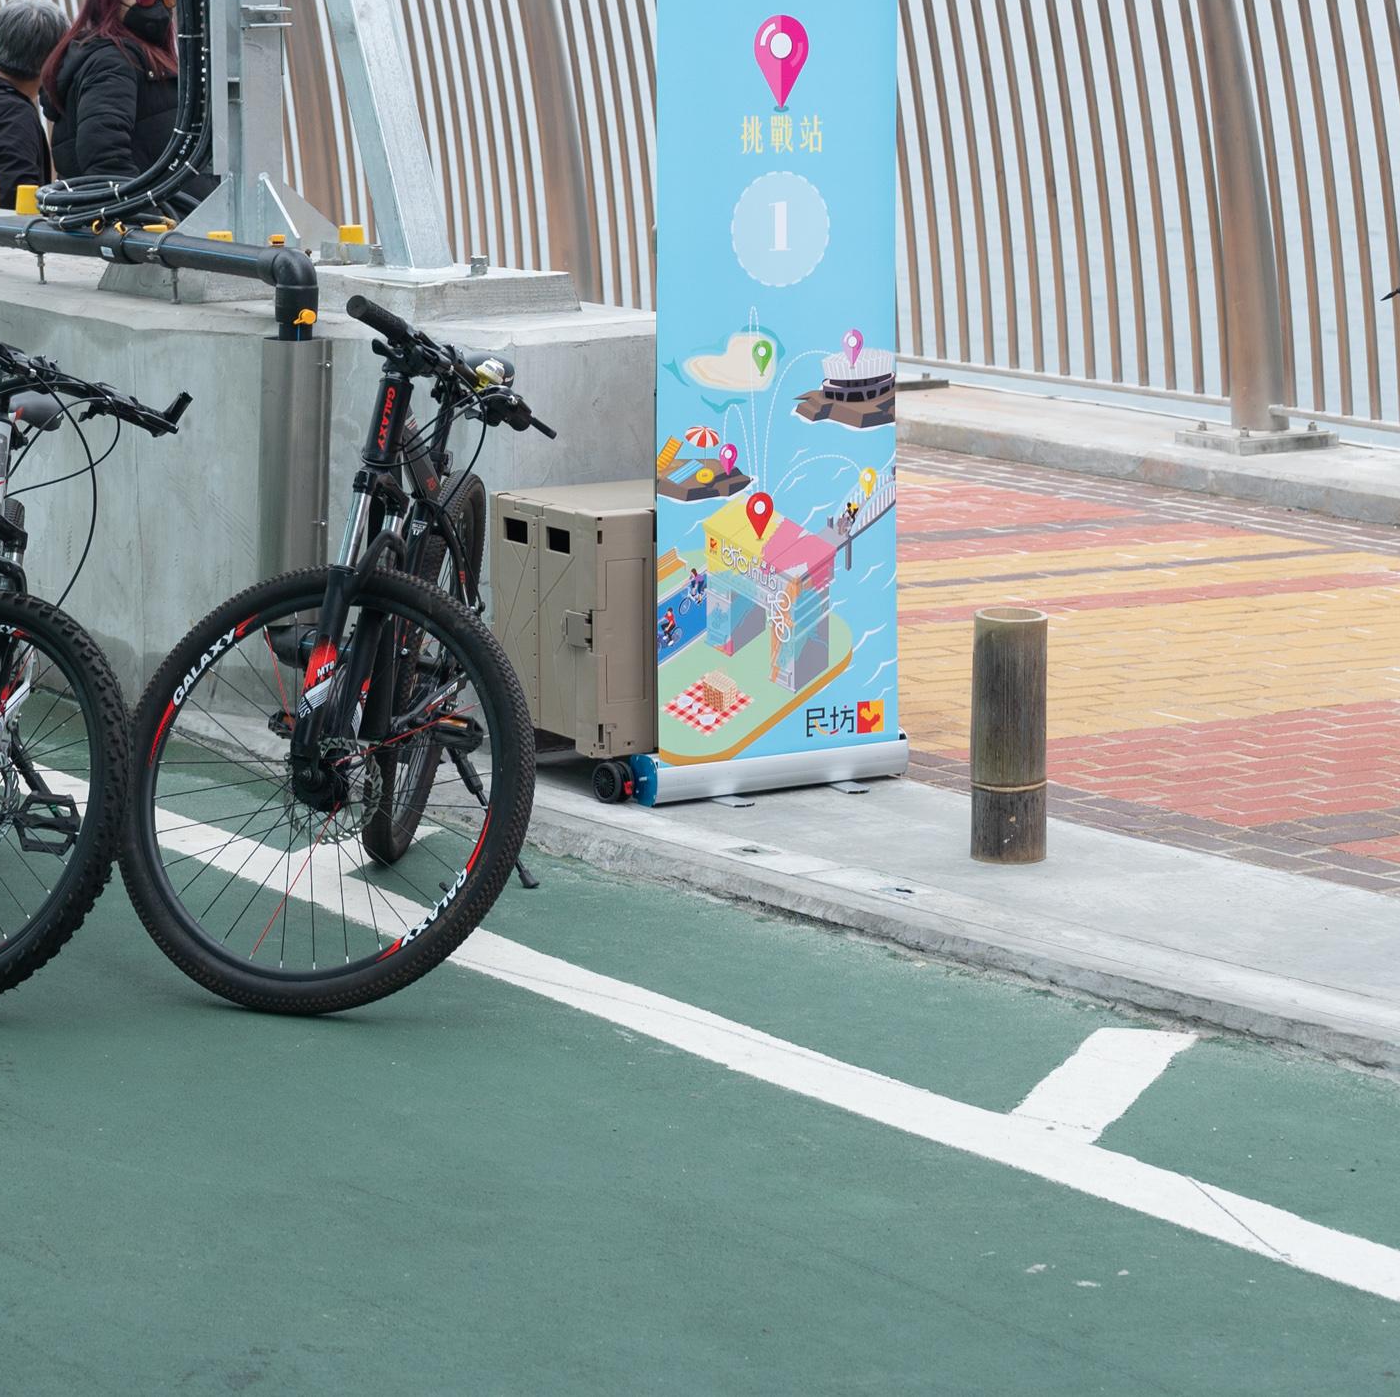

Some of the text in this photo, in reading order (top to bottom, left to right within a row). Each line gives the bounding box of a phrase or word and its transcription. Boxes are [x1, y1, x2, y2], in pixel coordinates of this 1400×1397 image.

[740, 115, 823, 155] 挑戰站
[768, 201, 792, 252] 1
[384, 386, 395, 451] GALAXY
[173, 627, 236, 706] GALAXY
[806, 704, 854, 737] 民坊
[401, 868, 468, 948] GALAXY
